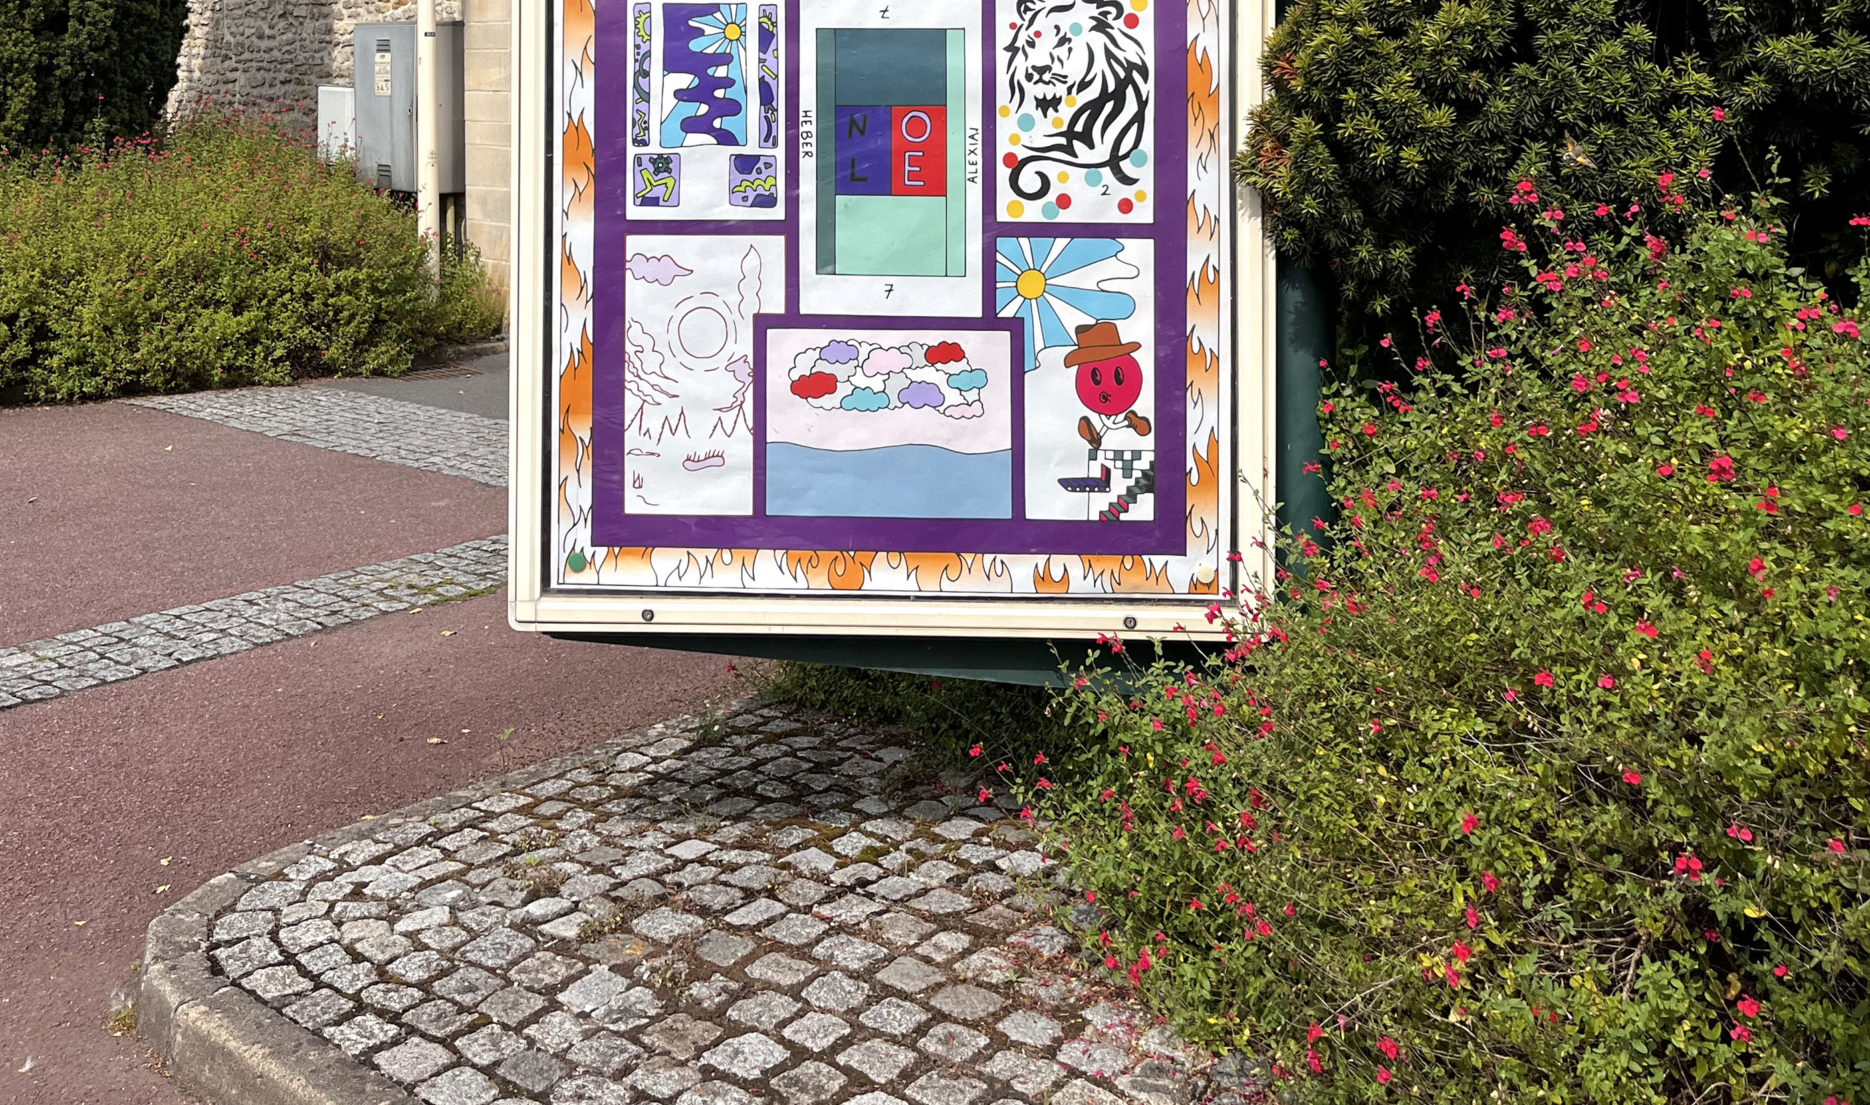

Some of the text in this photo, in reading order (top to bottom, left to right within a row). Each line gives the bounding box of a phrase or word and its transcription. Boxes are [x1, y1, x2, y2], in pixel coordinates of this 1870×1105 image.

[800, 109, 814, 159] HEBER
[1099, 184, 1112, 196] 2
[884, 283, 894, 299] 7
